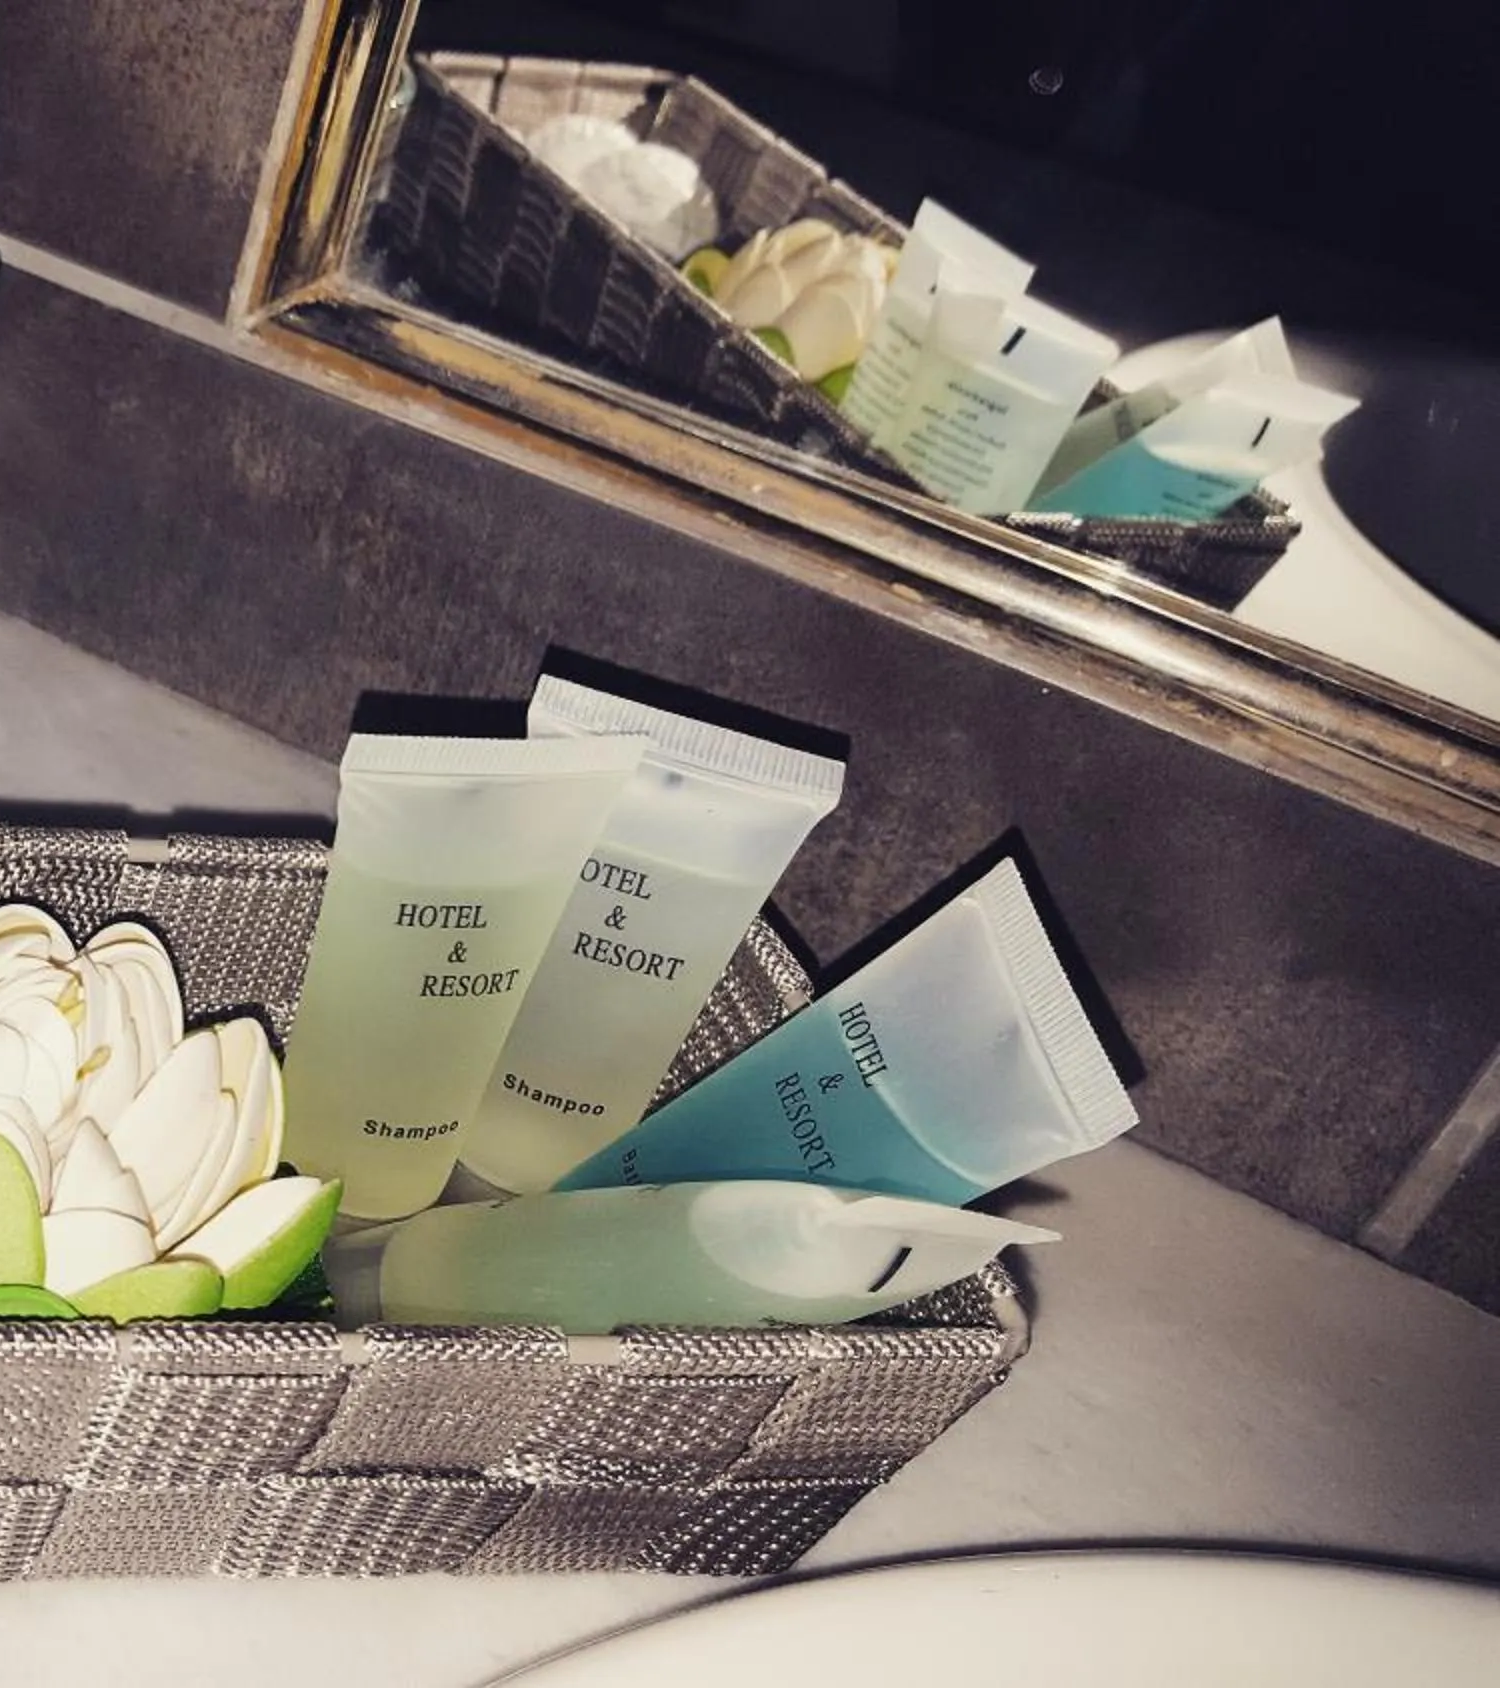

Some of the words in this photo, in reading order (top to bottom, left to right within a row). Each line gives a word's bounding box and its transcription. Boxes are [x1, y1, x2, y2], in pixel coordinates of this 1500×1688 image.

[579, 857, 653, 900] OTEL
[395, 903, 487, 930] HOTEL
[604, 905, 627, 931] &
[447, 941, 467, 963] &
[573, 932, 685, 981] RESORT
[420, 969, 519, 997] RESORT
[838, 1001, 888, 1089] HOTEL
[503, 1073, 605, 1116] Shampoo
[817, 1072, 845, 1095] &
[363, 1118, 460, 1141] Shampoo
[775, 1071, 836, 1176] RESORT
